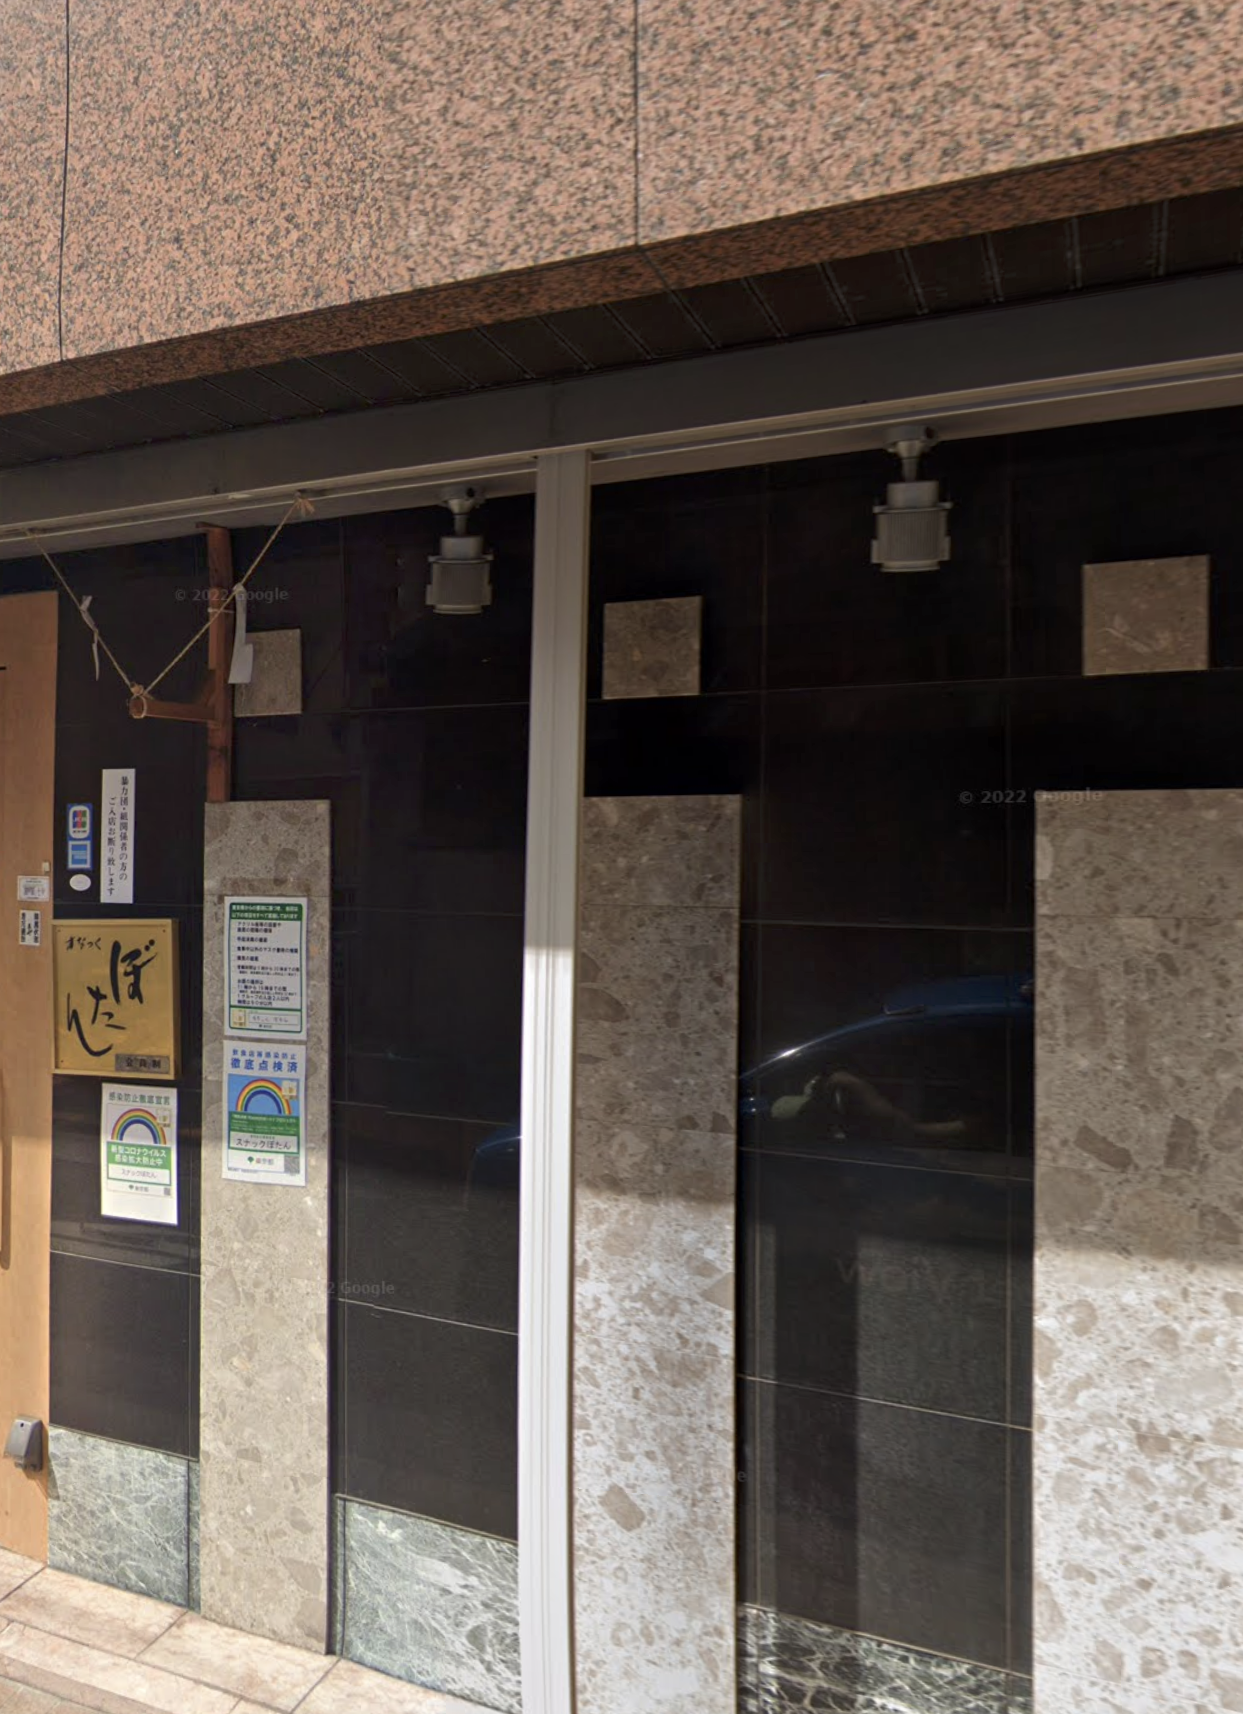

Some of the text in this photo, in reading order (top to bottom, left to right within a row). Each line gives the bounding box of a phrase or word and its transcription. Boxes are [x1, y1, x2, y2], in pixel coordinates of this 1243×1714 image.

[231, 1057, 298, 1073] 徹底点検済
[110, 1144, 167, 1158] 新型コロナウイルス
[236, 1138, 292, 1151] スナックぼたん
